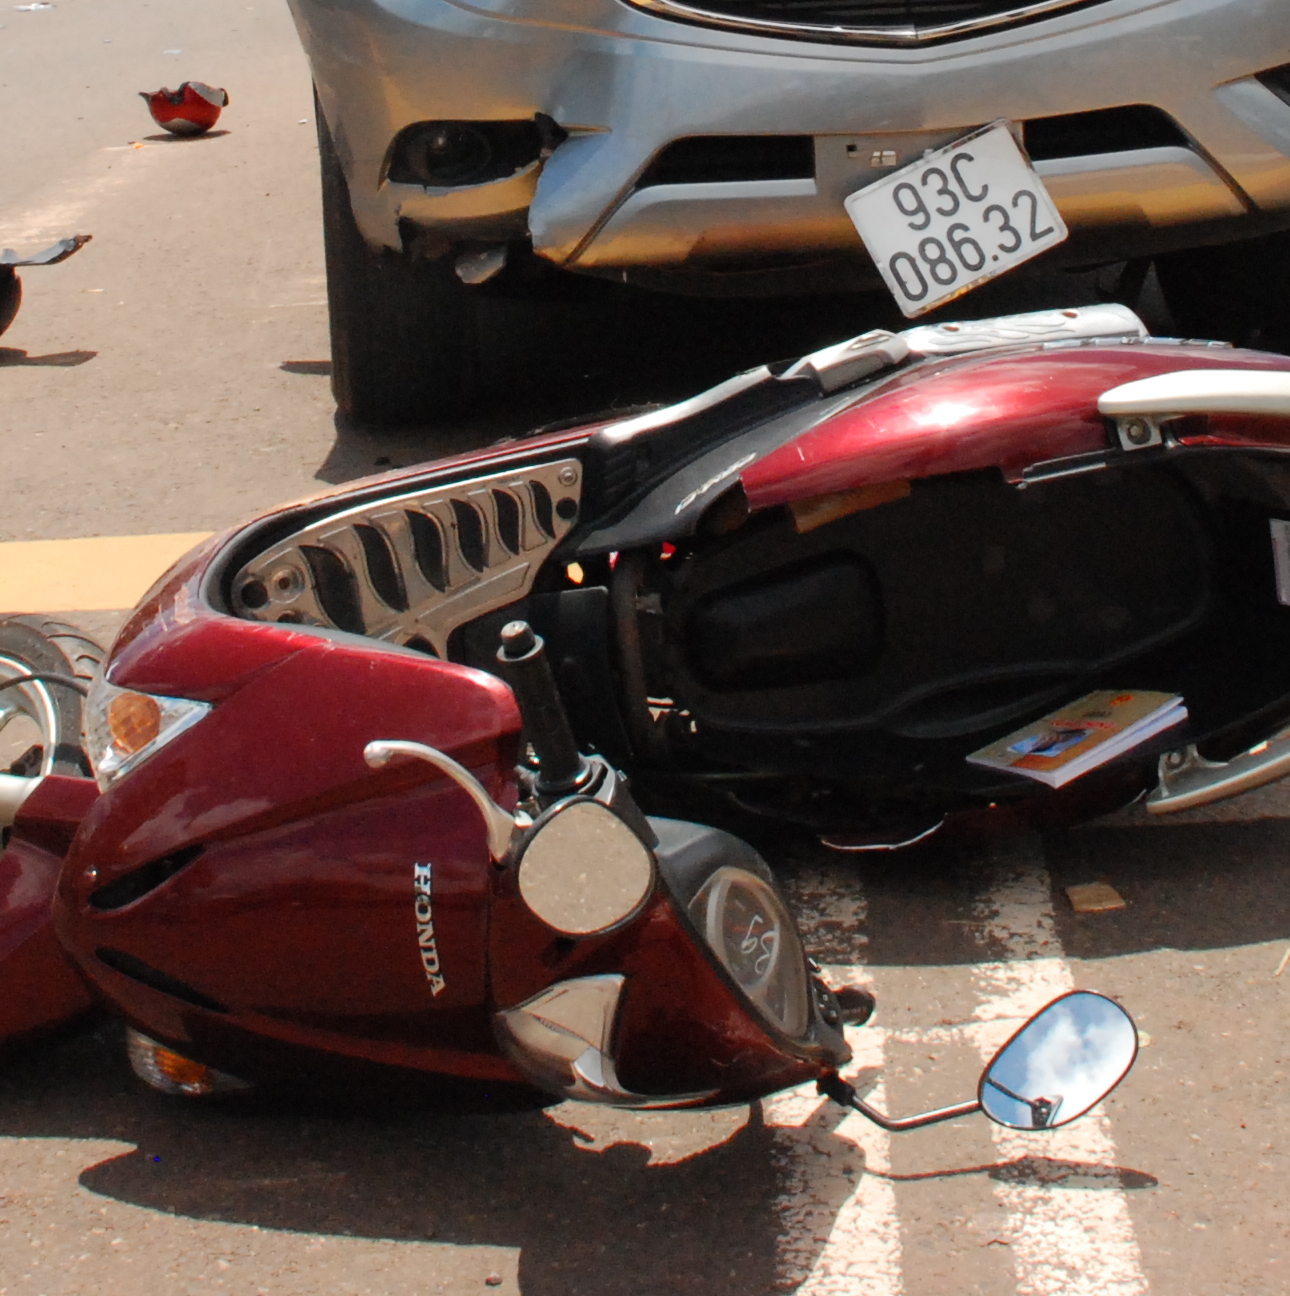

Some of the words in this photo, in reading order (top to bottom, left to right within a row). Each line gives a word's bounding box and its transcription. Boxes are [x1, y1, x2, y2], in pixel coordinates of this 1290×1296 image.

[889, 189, 1054, 302] 086.32
[893, 152, 989, 231] 93C
[414, 862, 446, 997] HONDA
